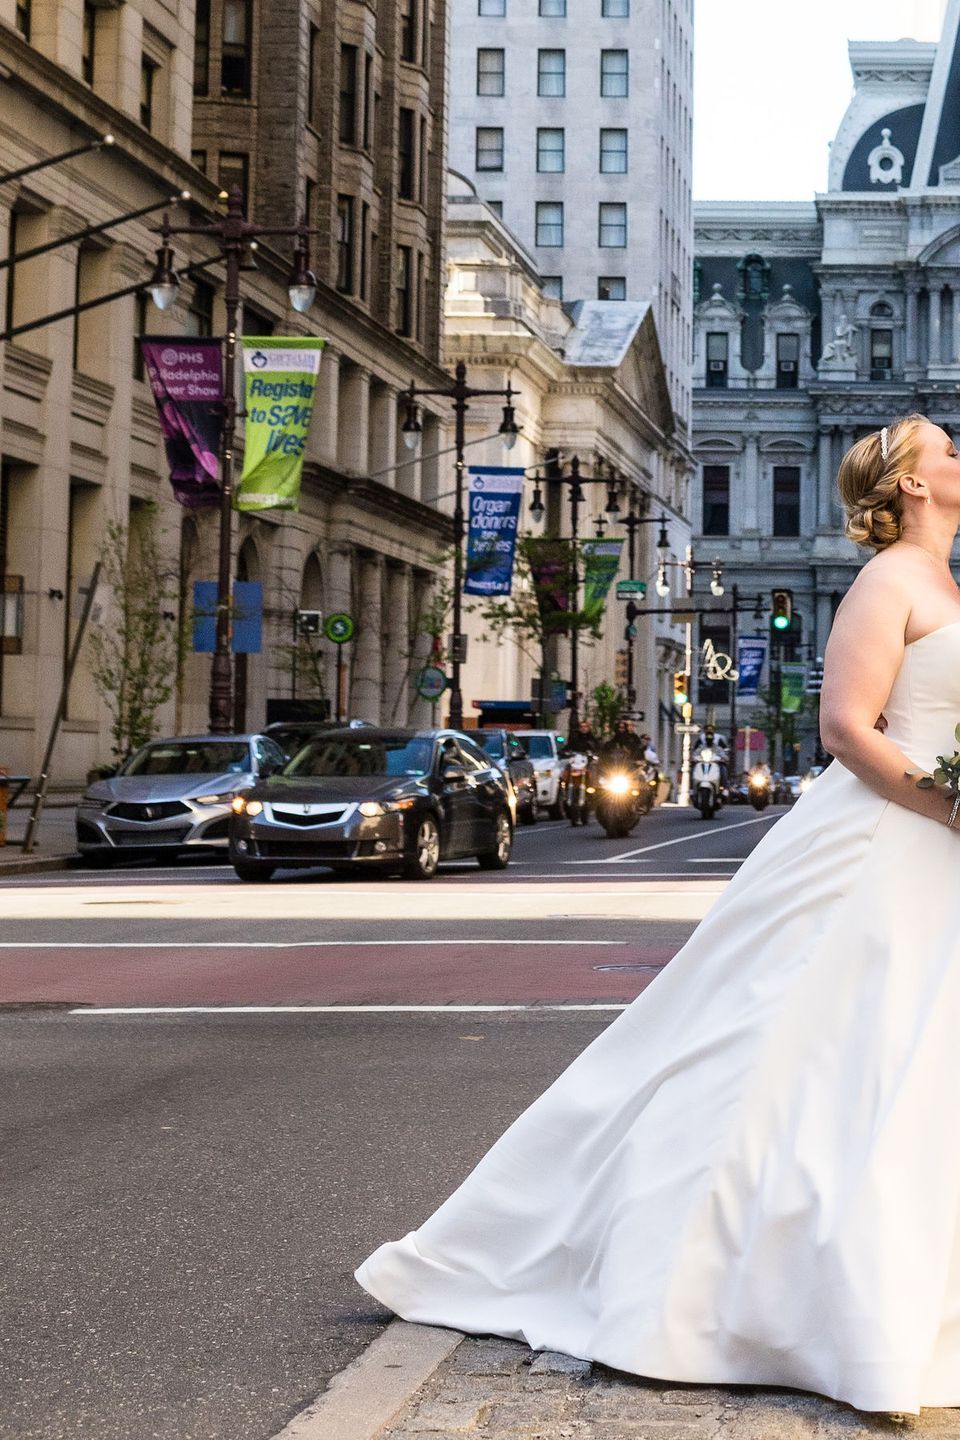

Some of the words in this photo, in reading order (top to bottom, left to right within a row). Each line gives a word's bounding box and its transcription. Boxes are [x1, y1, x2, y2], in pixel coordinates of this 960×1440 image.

[179, 352, 204, 364] PHS
[187, 383, 220, 397] Show
[251, 407, 267, 423] to
[265, 430, 307, 457] lives
[472, 496, 513, 516] Organ
